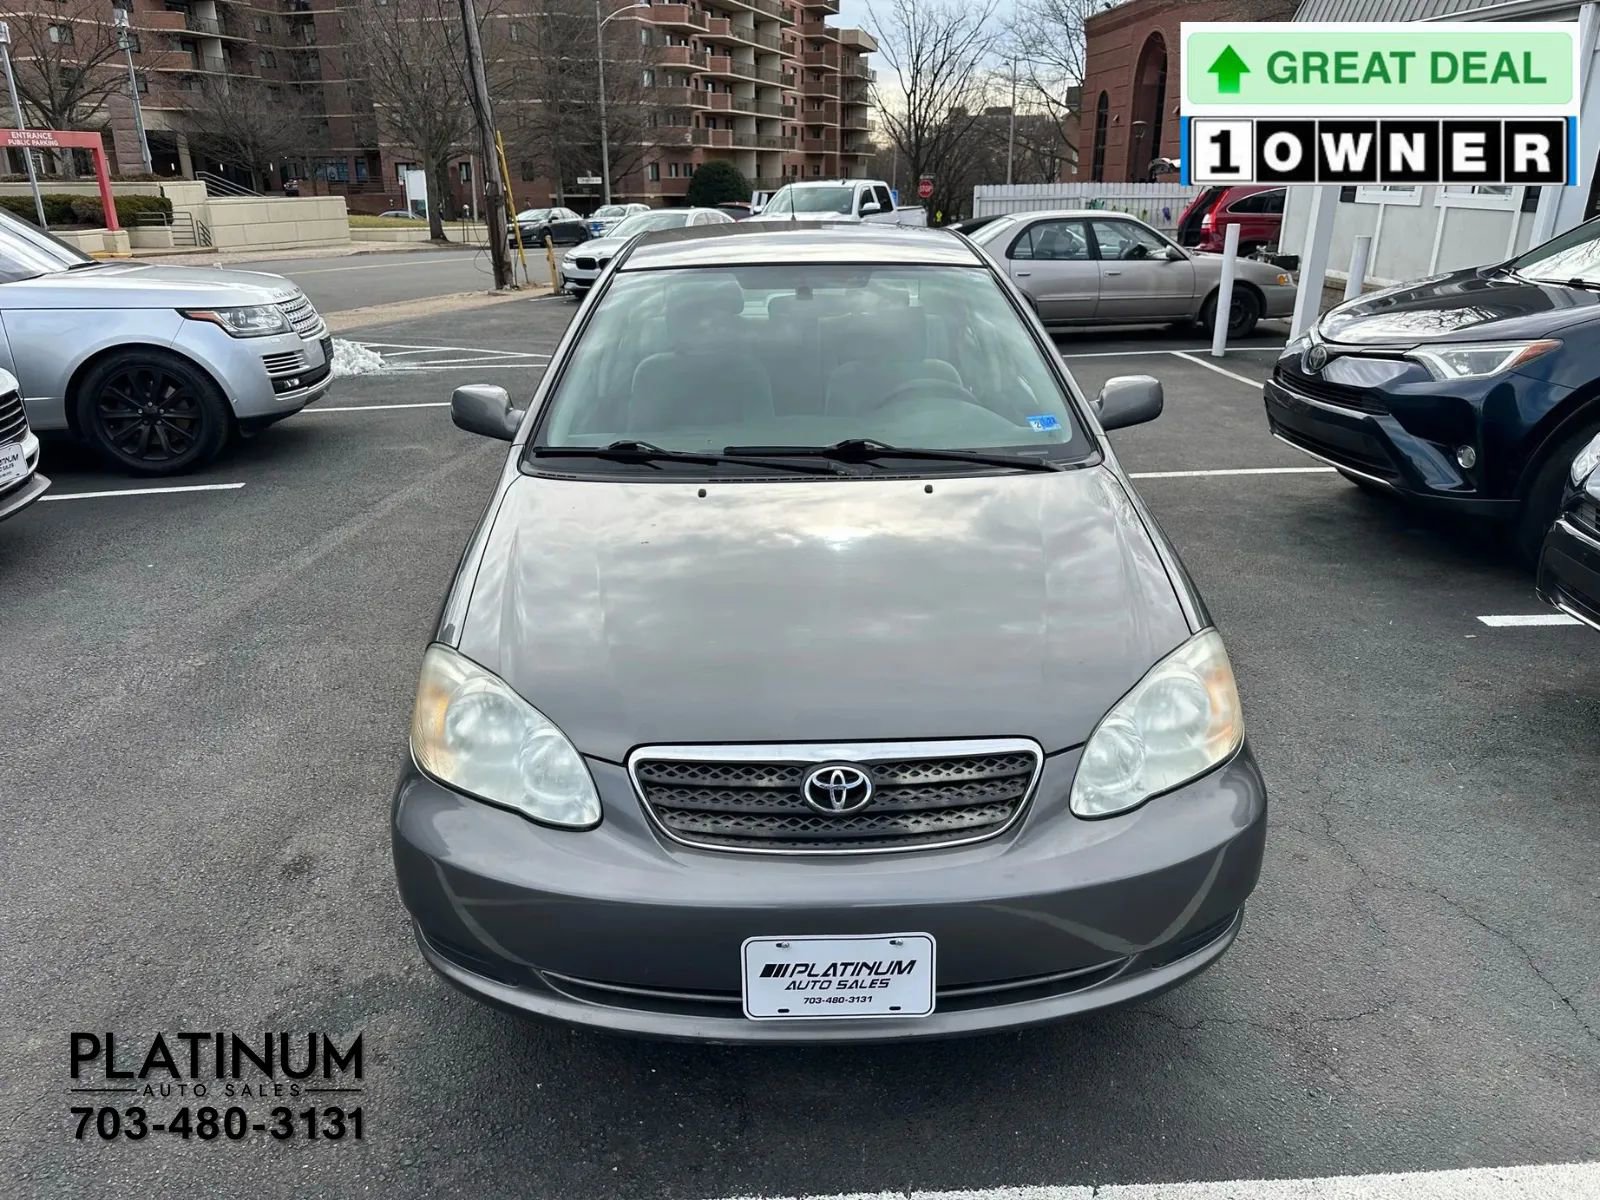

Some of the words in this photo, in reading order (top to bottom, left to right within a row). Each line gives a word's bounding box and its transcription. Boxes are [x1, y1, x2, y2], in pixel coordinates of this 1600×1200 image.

[11, 131, 52, 139] ENTRANCE
[790, 960, 916, 977] PLATINUM
[785, 980, 832, 990] AUTO
[836, 978, 891, 989] SALES
[804, 996, 873, 1004] 703-480-3131
